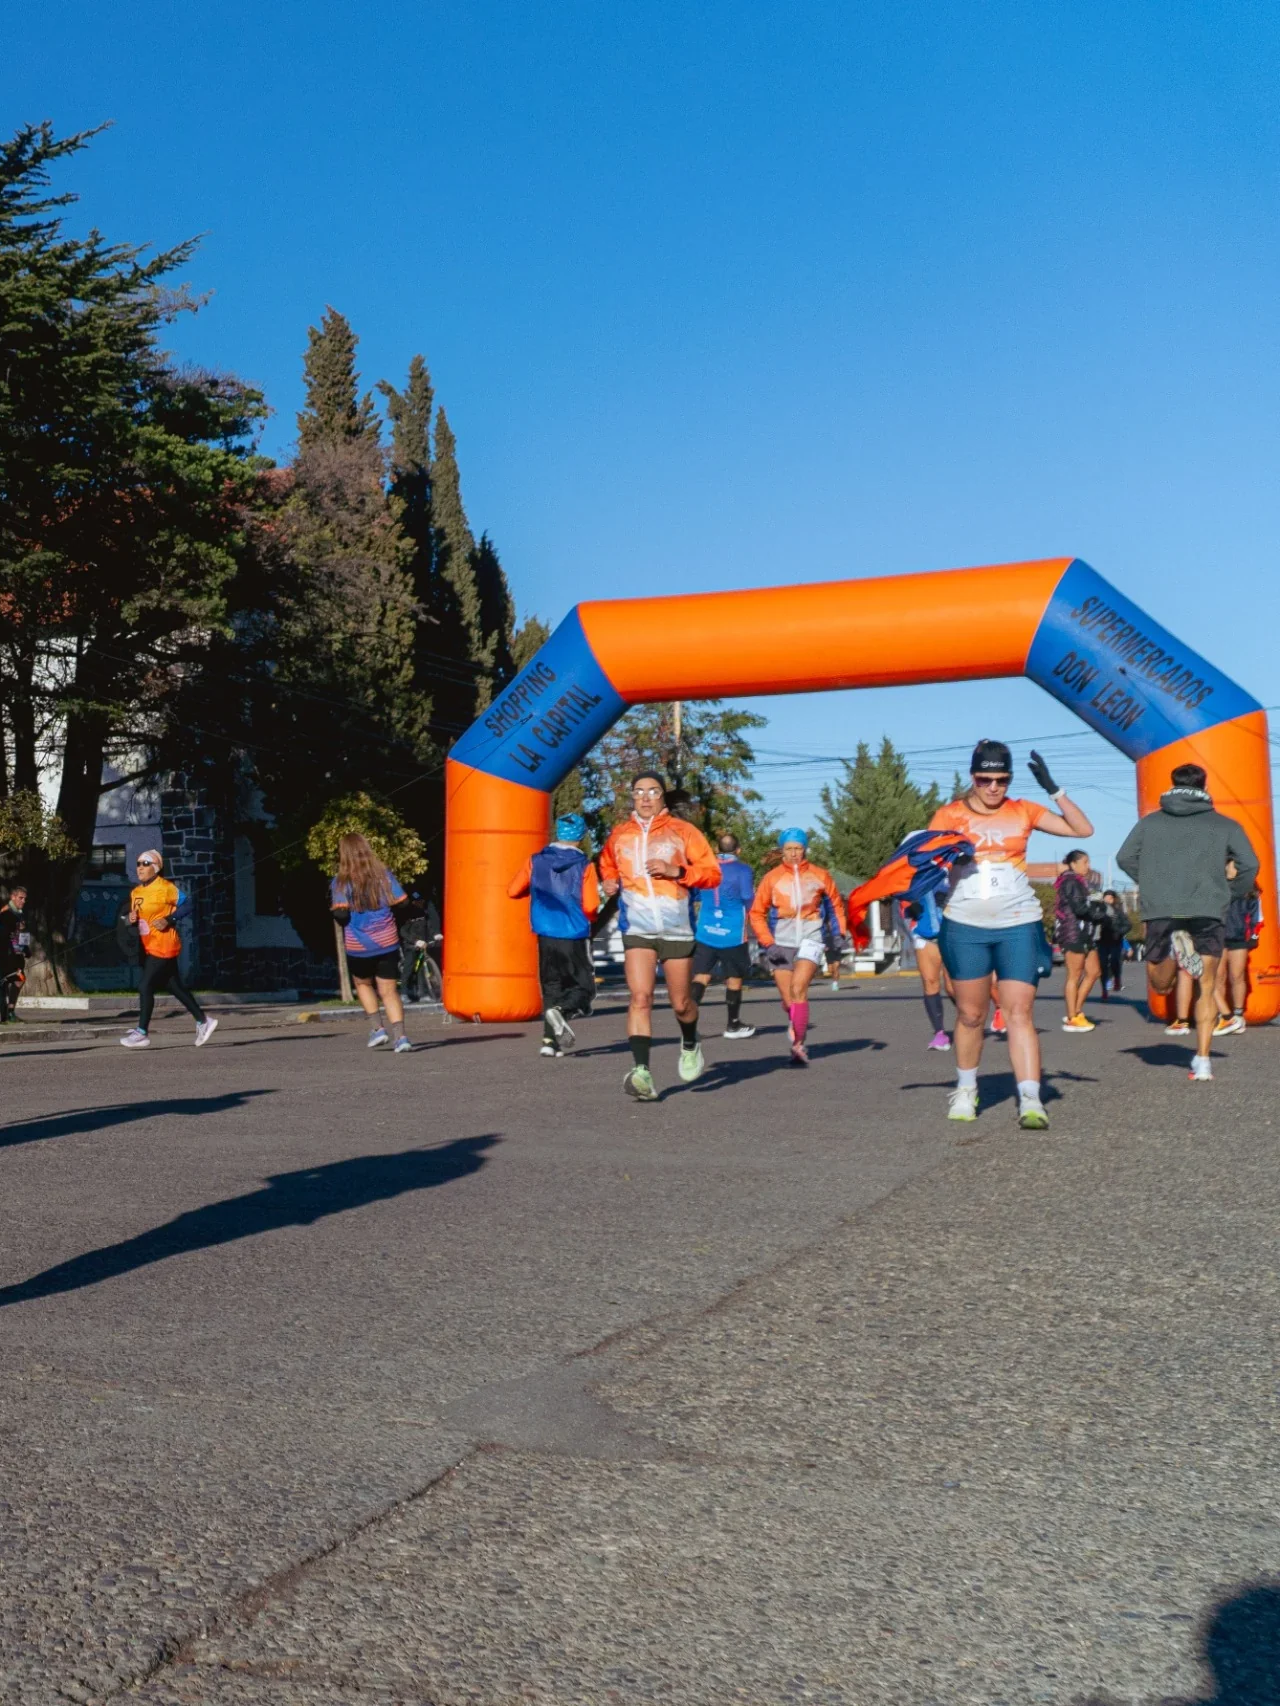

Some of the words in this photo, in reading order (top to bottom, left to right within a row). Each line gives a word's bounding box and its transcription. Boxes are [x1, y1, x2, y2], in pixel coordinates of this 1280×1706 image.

[1051, 651, 1099, 694] DON
[1090, 681, 1146, 732] LEON
[1071, 595, 1213, 710] SUPERMERCADOS
[485, 661, 556, 738] SHOPPING
[509, 743, 546, 773] LA
[532, 684, 603, 749] CAPITAL
